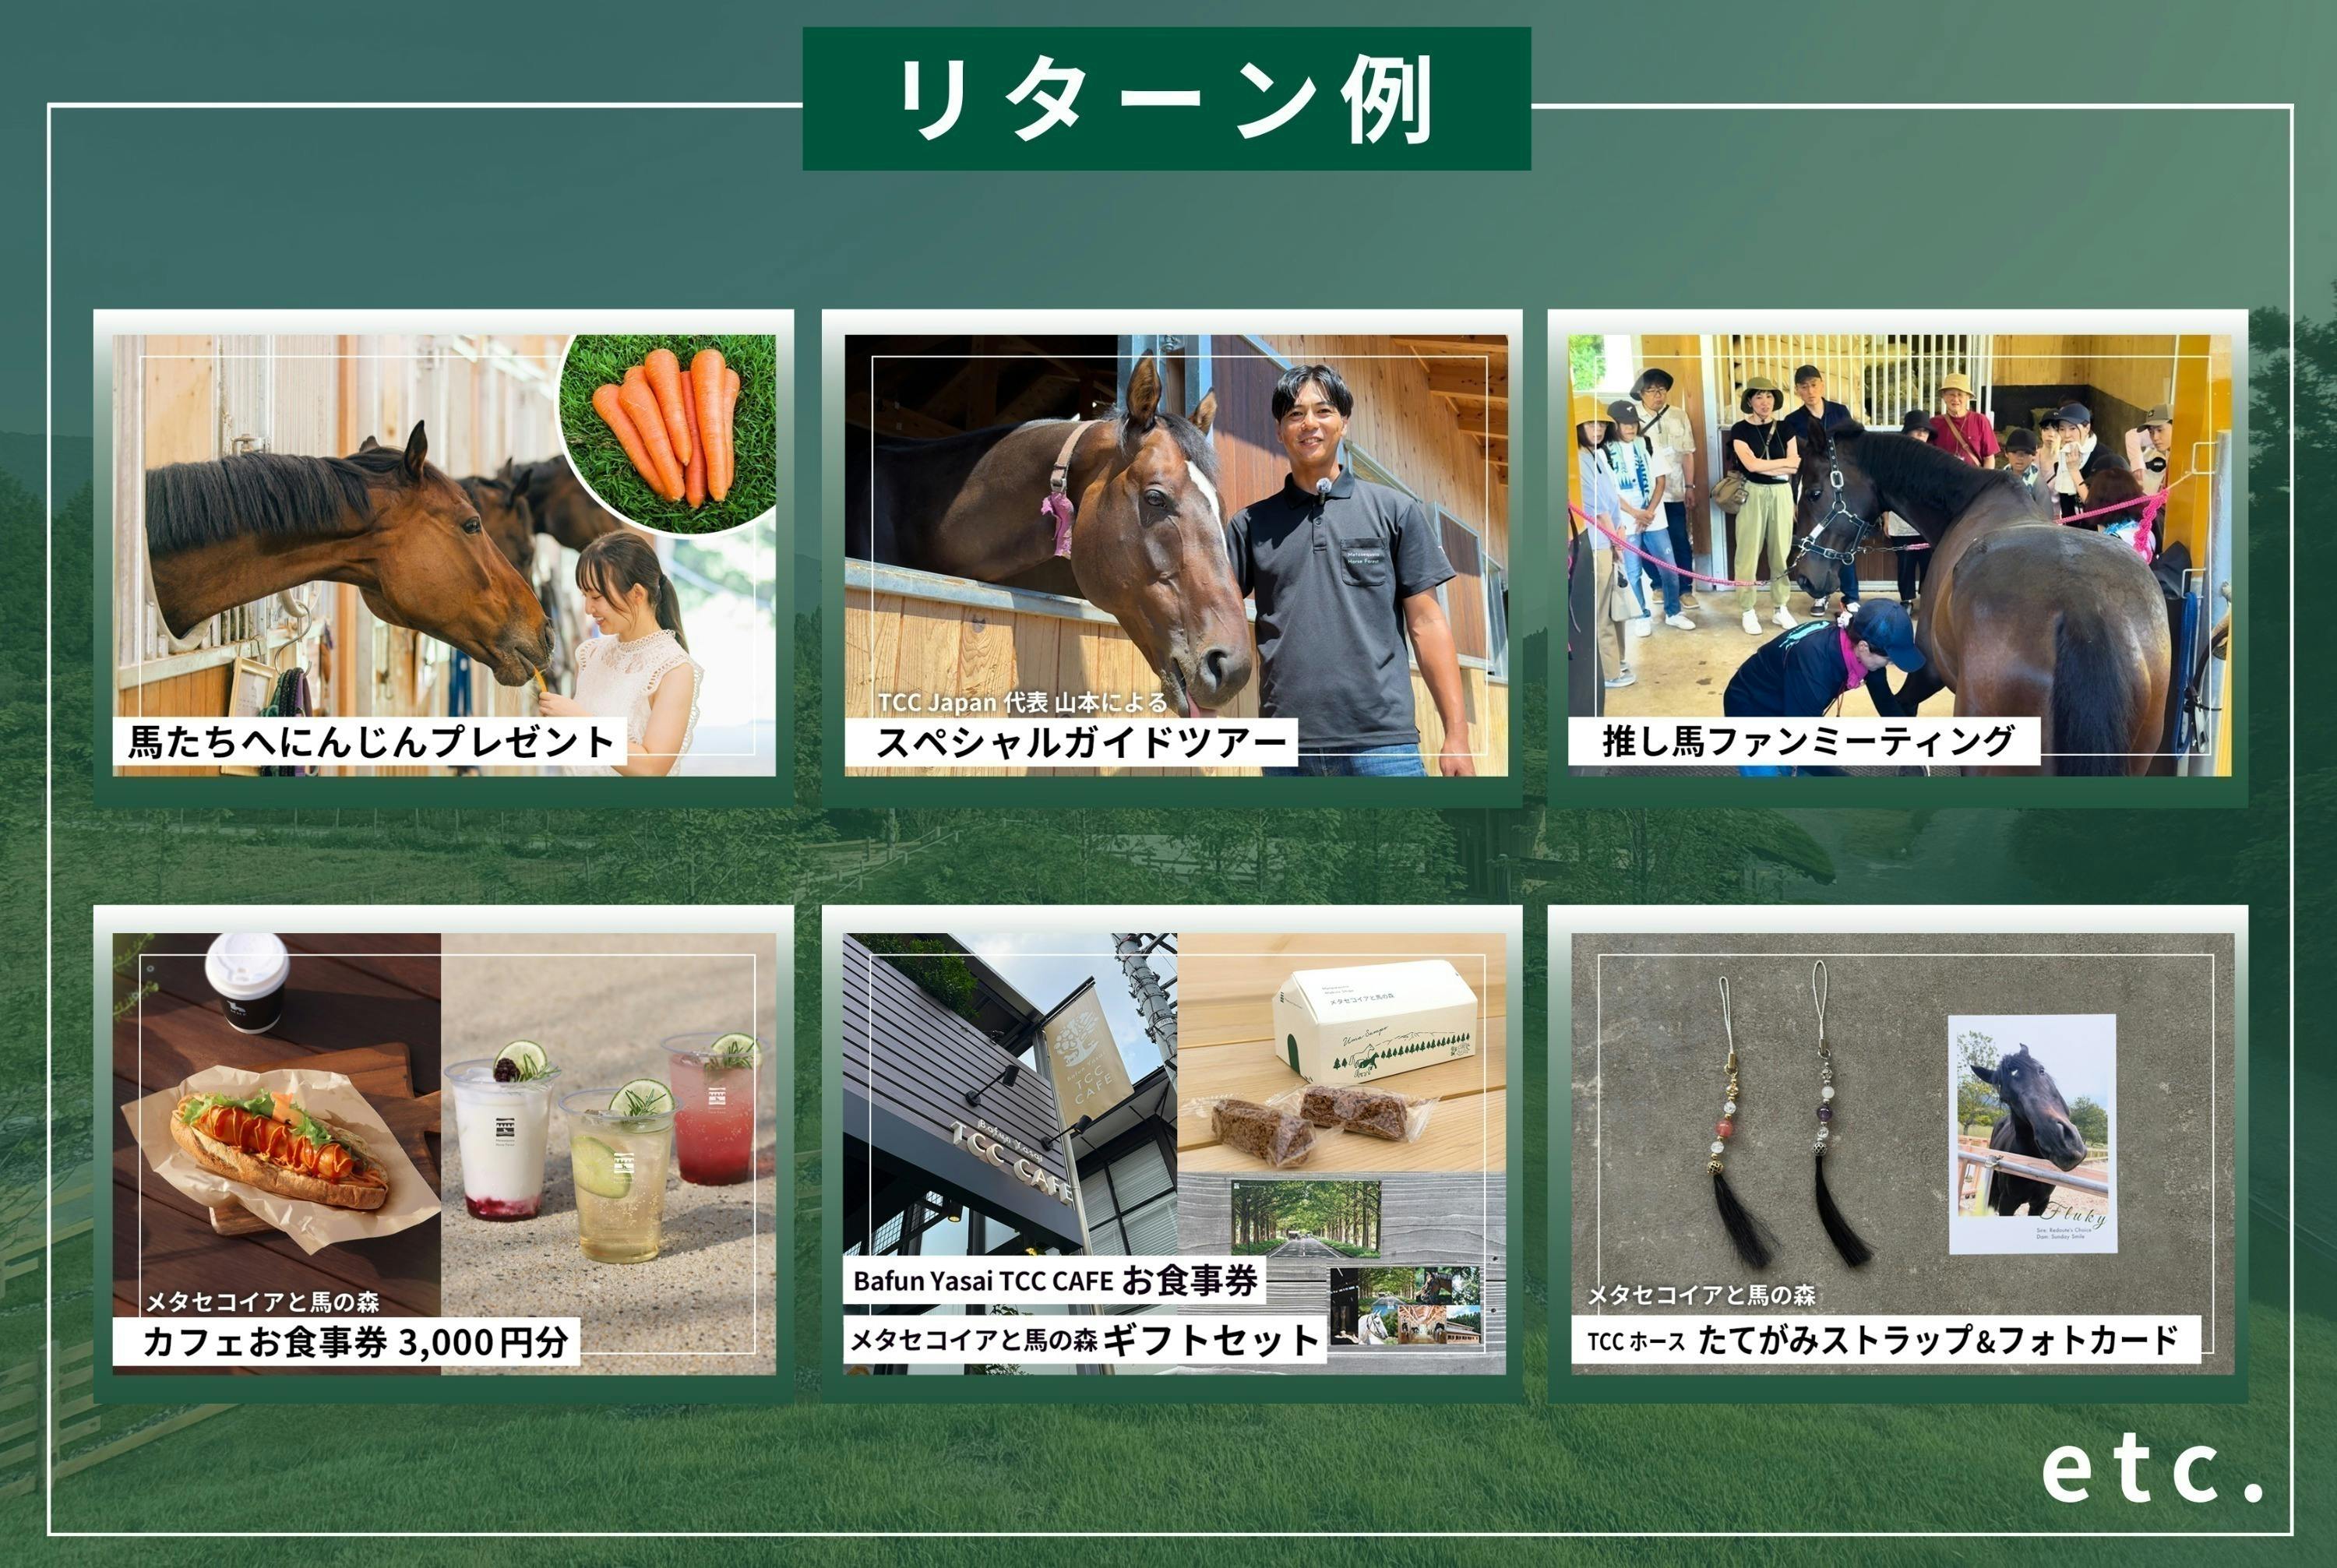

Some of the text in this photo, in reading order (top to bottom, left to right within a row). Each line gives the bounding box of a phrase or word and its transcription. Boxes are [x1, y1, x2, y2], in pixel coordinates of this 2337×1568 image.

[1075, 1073, 1112, 1105] CAFE
[1076, 1065, 1104, 1090] TCC
[978, 1119, 1043, 1163] Bafun Yasai
[950, 1120, 1074, 1205] TCC CAFE
[2039, 1200, 2106, 1230] Fluky
